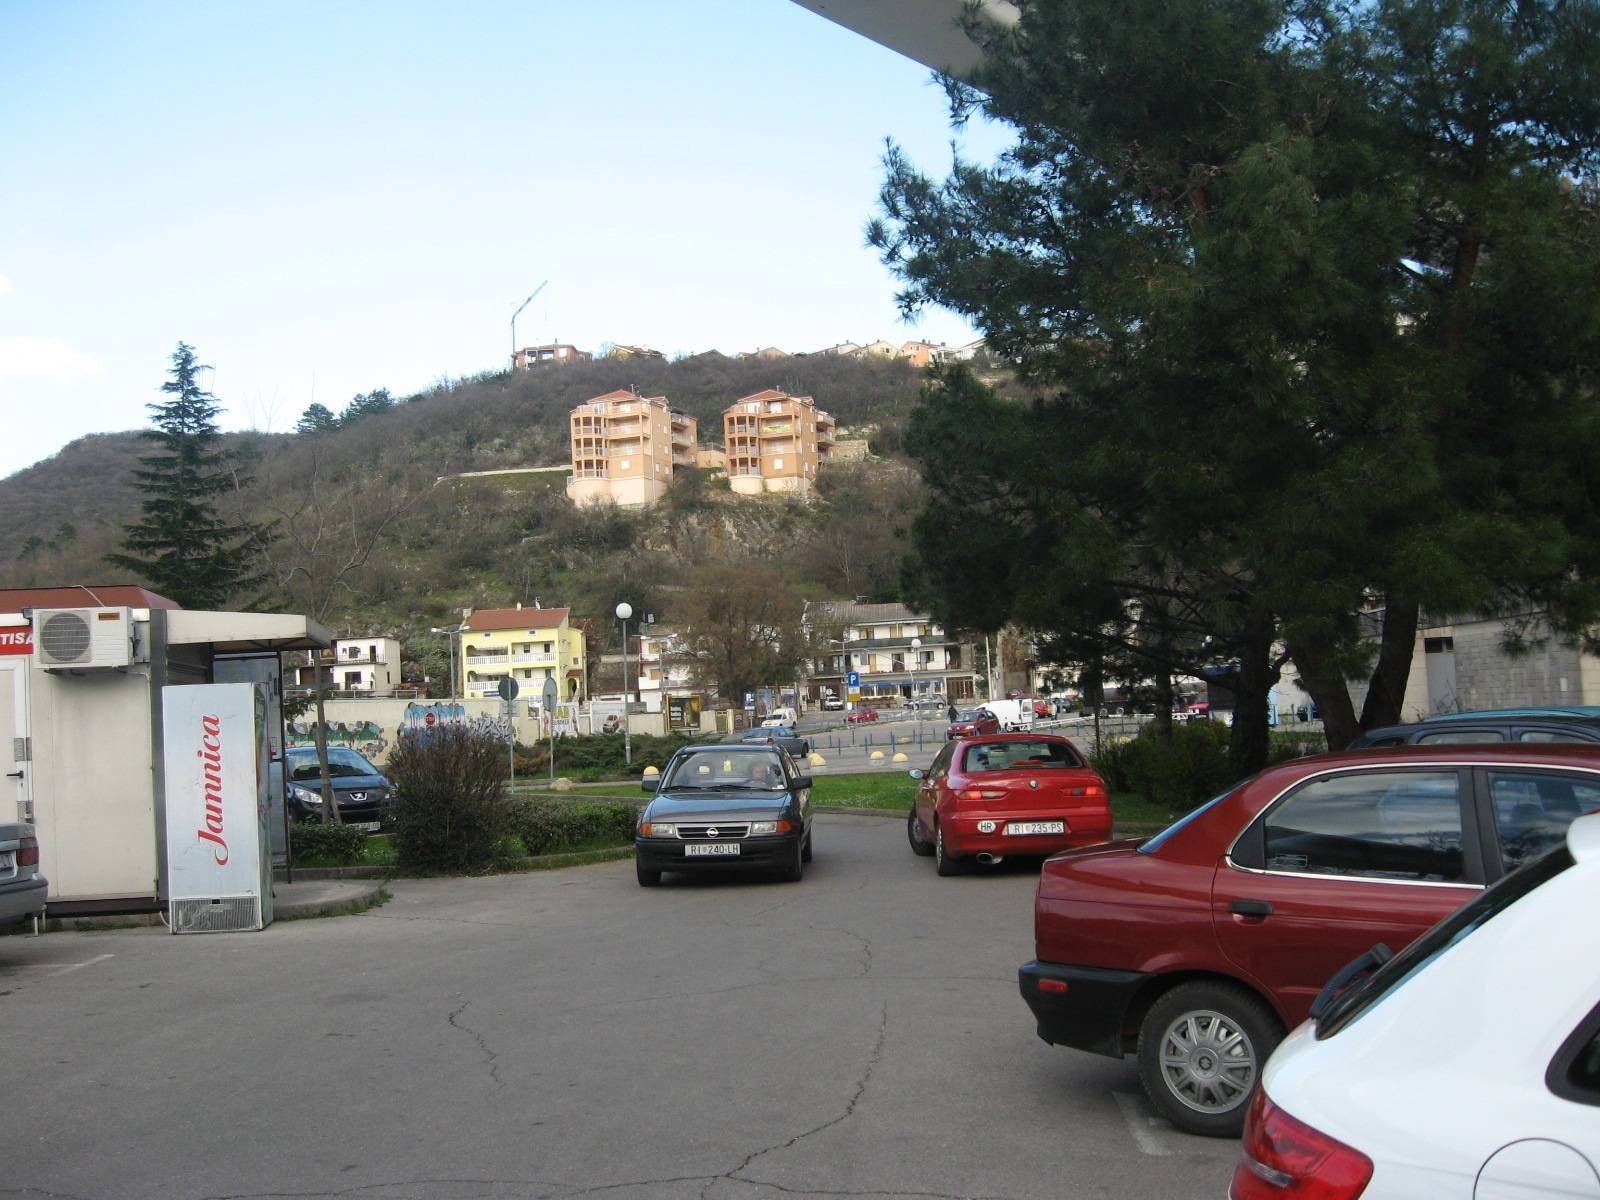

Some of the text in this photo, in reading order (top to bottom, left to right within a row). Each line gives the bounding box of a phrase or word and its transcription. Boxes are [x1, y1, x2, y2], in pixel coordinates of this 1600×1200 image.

[850, 674, 857, 685] P
[197, 713, 230, 866] Jamnica
[980, 823, 993, 832] HR
